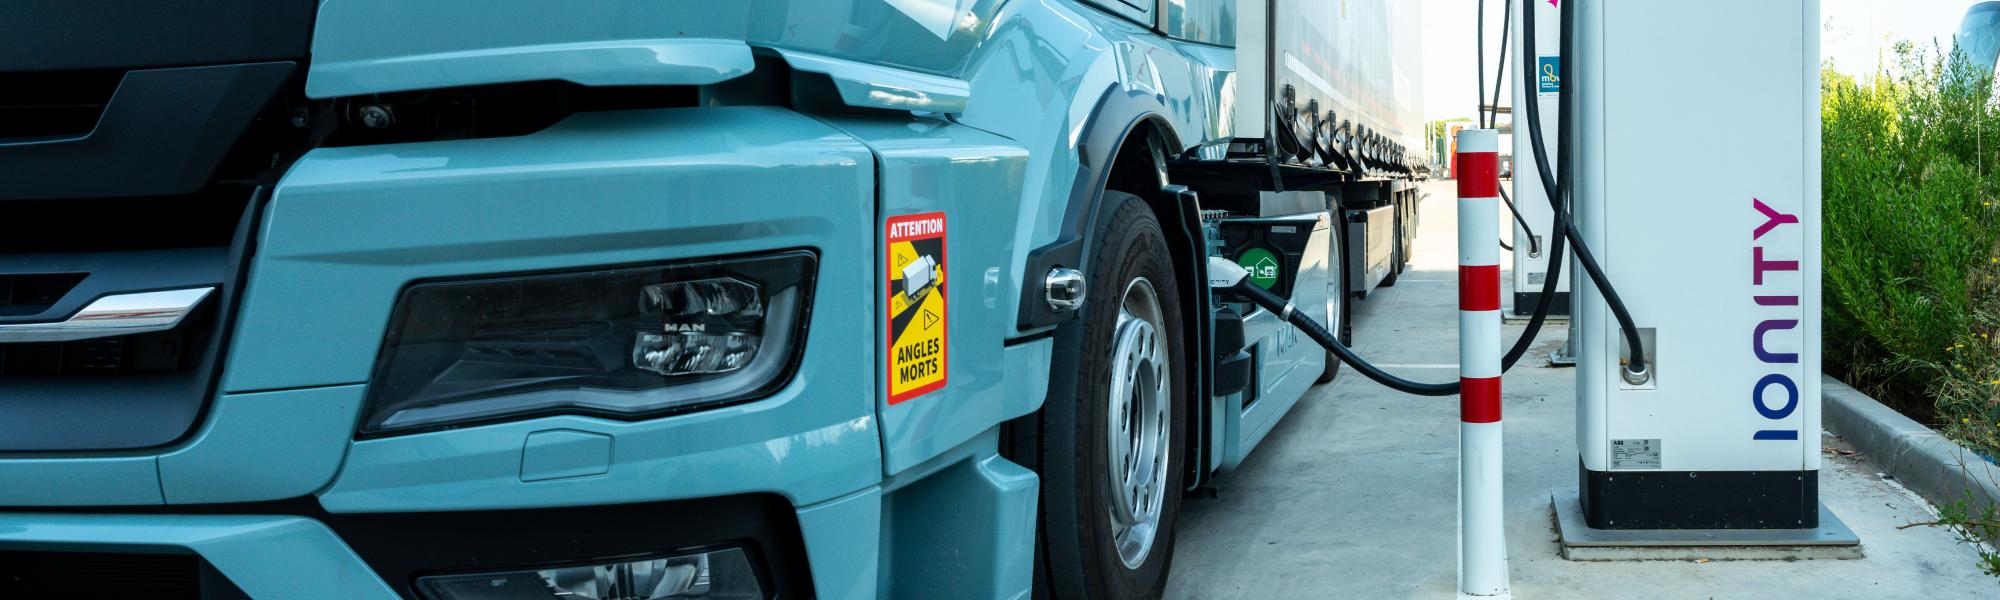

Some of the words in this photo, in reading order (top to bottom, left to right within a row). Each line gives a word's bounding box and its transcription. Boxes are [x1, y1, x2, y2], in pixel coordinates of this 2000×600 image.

[890, 218, 943, 238] ATTENTION
[664, 323, 705, 332] MAN
[1753, 197, 1799, 440] IONITY
[897, 338, 940, 365] ANGLES
[900, 358, 938, 384] MORTS
